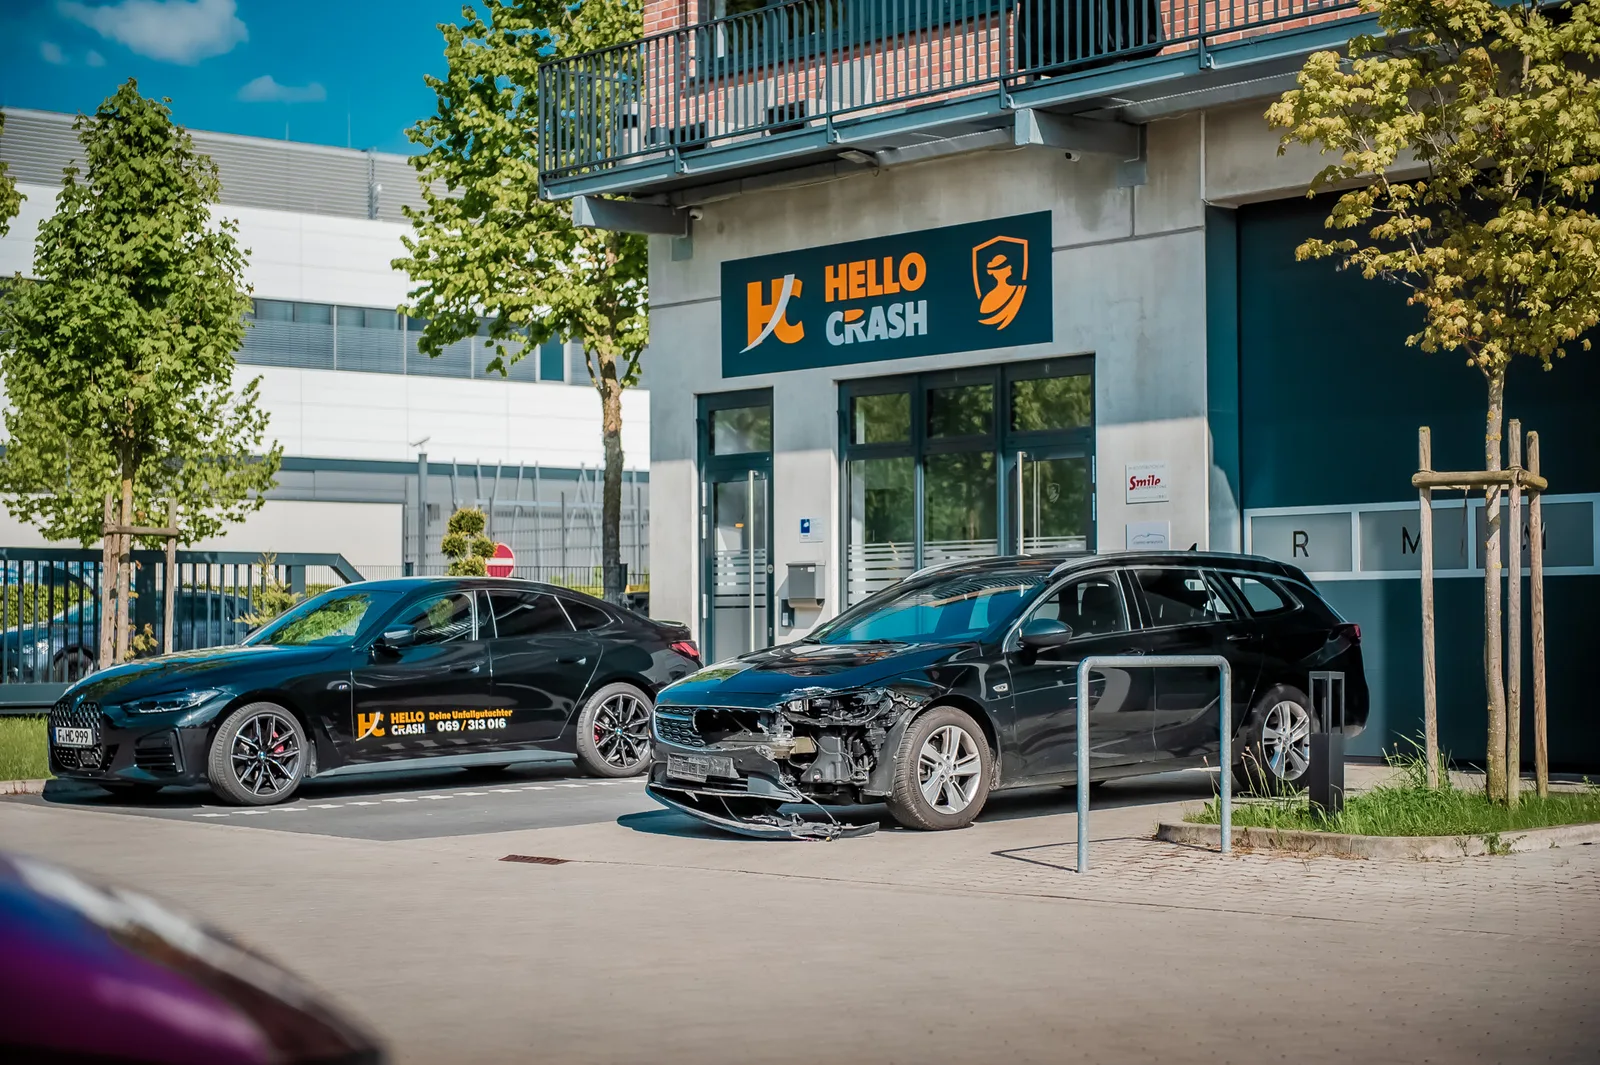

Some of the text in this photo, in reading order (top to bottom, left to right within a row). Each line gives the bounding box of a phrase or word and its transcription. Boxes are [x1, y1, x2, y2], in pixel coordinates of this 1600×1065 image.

[825, 252, 927, 303] HELLO
[825, 300, 928, 346] CRASH
[1129, 474, 1161, 491] Smile
[1292, 530, 1310, 558] R
[1402, 526, 1421, 554] M
[390, 711, 425, 724] HELLO
[429, 709, 513, 721] Deine Unfallgutachter
[391, 723, 426, 735] CRASH
[437, 718, 506, 732] 069 / 313 016
